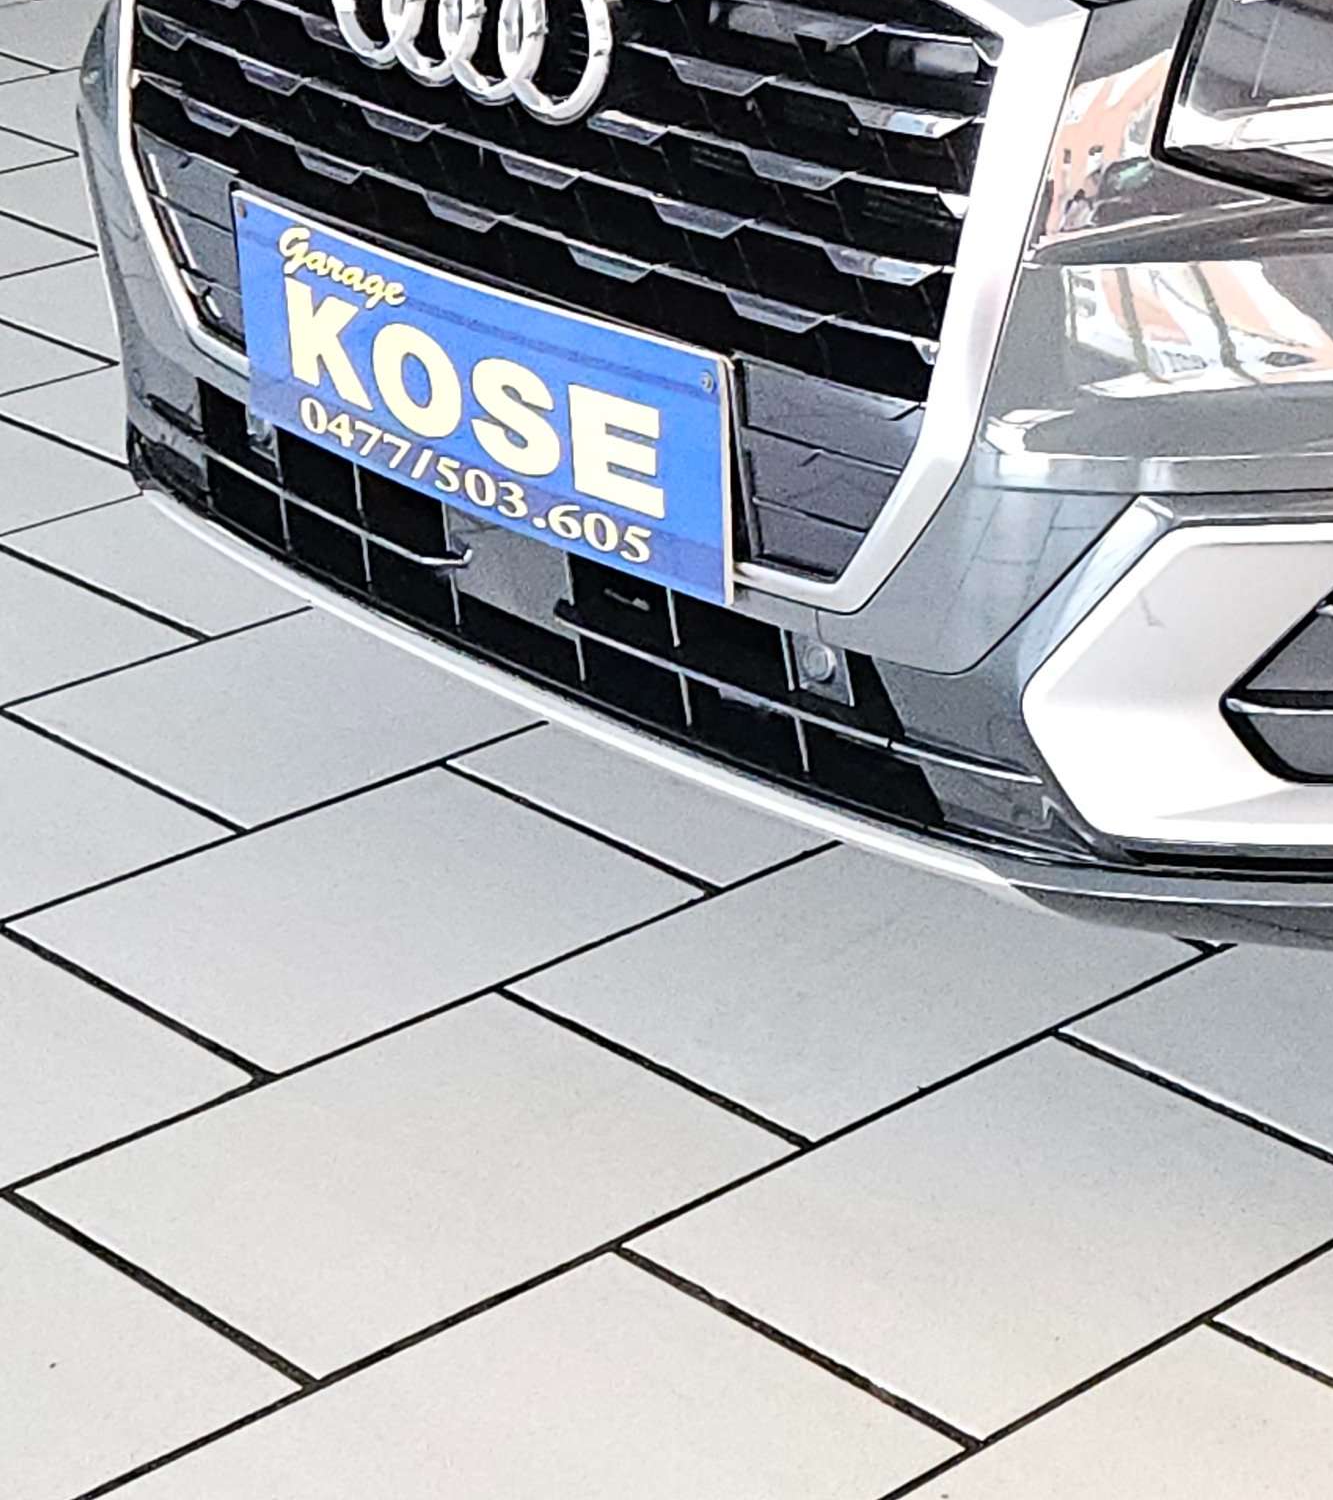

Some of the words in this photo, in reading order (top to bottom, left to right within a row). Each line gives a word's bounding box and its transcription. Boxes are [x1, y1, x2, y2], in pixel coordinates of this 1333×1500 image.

[278, 226, 406, 308] Garage
[284, 276, 665, 519] KOSE
[300, 397, 652, 564] 0477/503.605
